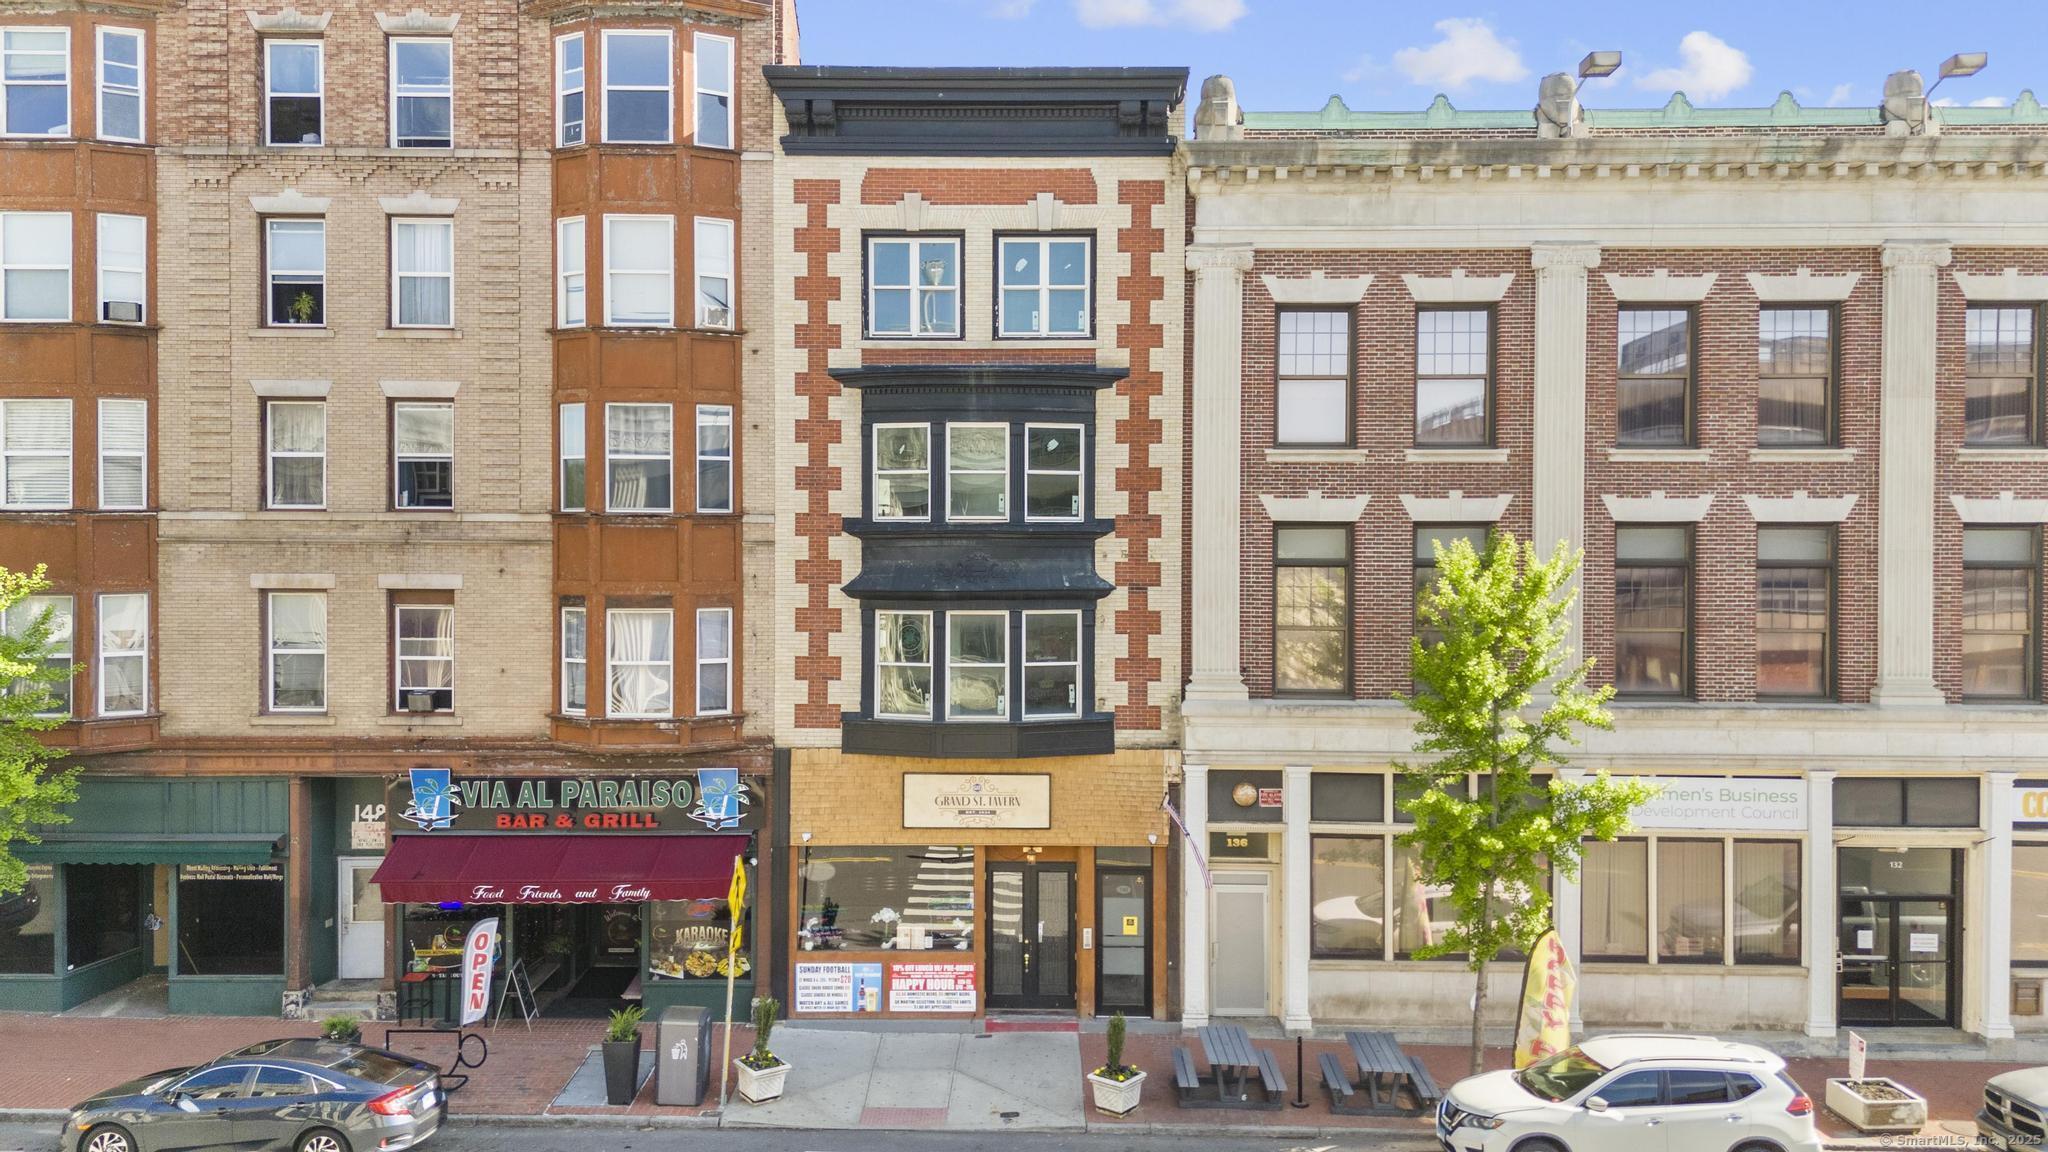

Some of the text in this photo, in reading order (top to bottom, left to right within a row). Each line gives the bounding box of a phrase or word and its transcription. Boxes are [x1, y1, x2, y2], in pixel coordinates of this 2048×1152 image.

[461, 780, 693, 809] VIA AL PARAISO
[934, 796, 971, 807] GRAND
[989, 796, 1021, 807] TAVERN
[1719, 788, 1798, 803] Business
[1631, 805, 1799, 820] Development Council
[495, 813, 659, 830] BAR & GRILL
[1226, 838, 1248, 848] 136
[1889, 861, 1903, 869] 132
[470, 884, 652, 900] Food Friends and Family
[675, 925, 729, 945] KARAOKE
[470, 933, 489, 1011] OPEN
[799, 965, 851, 974] SUNDAY FOOTBALL
[892, 978, 926, 991] HAPPY
[926, 978, 955, 991] HOUR
